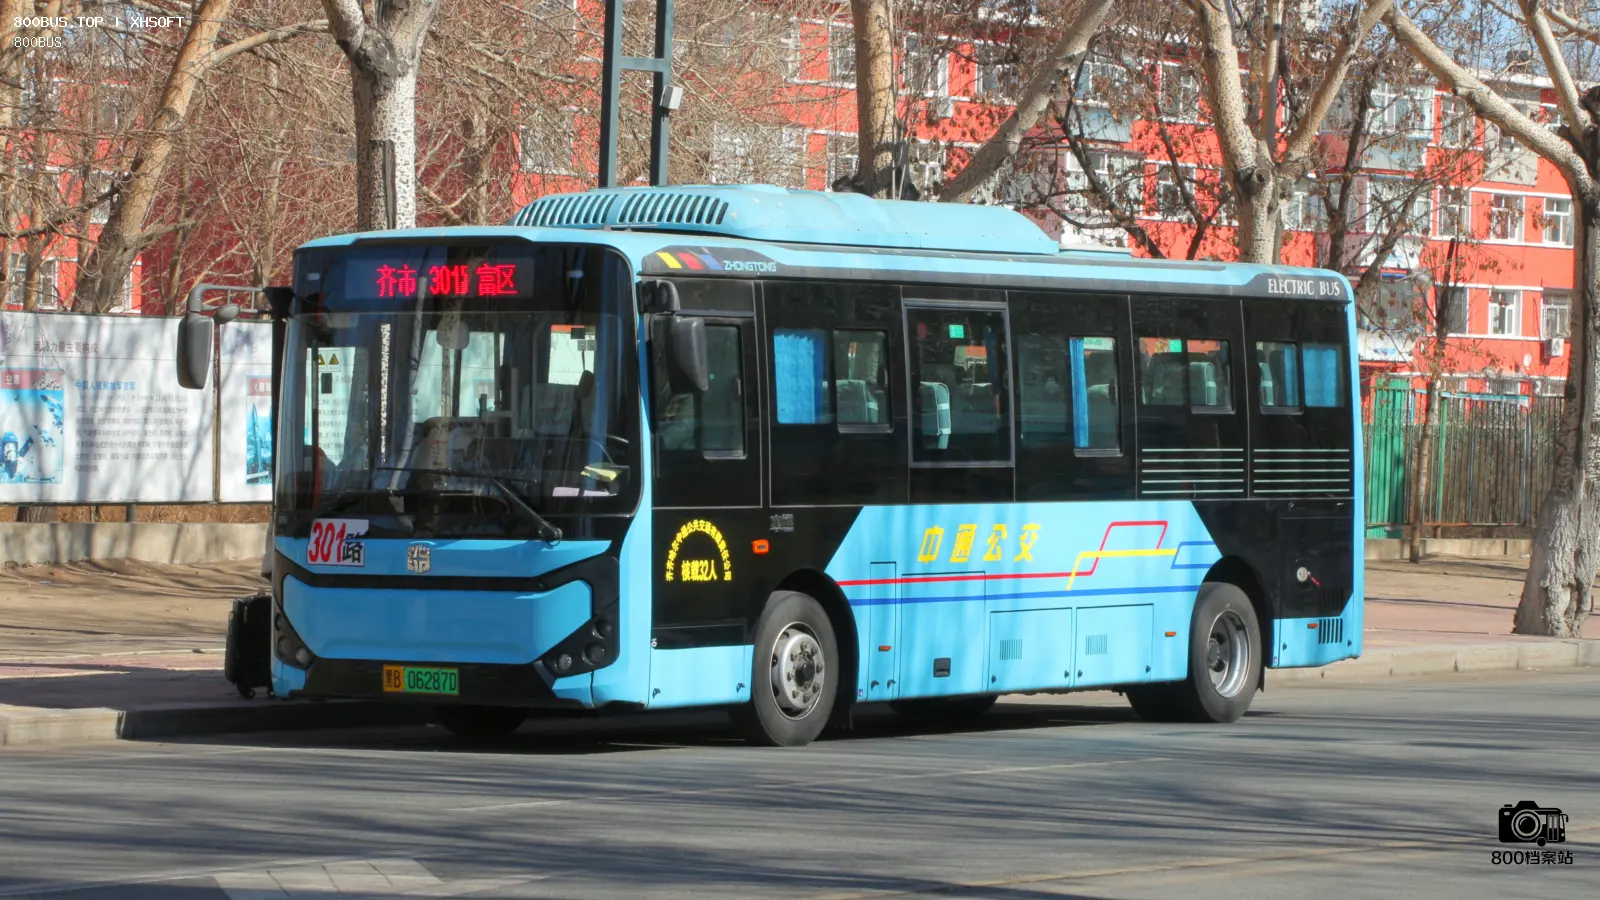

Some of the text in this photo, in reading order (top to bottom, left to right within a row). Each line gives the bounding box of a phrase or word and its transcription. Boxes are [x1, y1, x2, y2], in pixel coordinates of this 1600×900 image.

[723, 260, 777, 272] ZHONGTONG
[376, 264, 417, 297] 齐市
[476, 263, 518, 296] 富区
[1267, 278, 1341, 296] ELECTRIC BUS
[918, 523, 1041, 564] 中通公交
[681, 560, 718, 581] 核载32人
